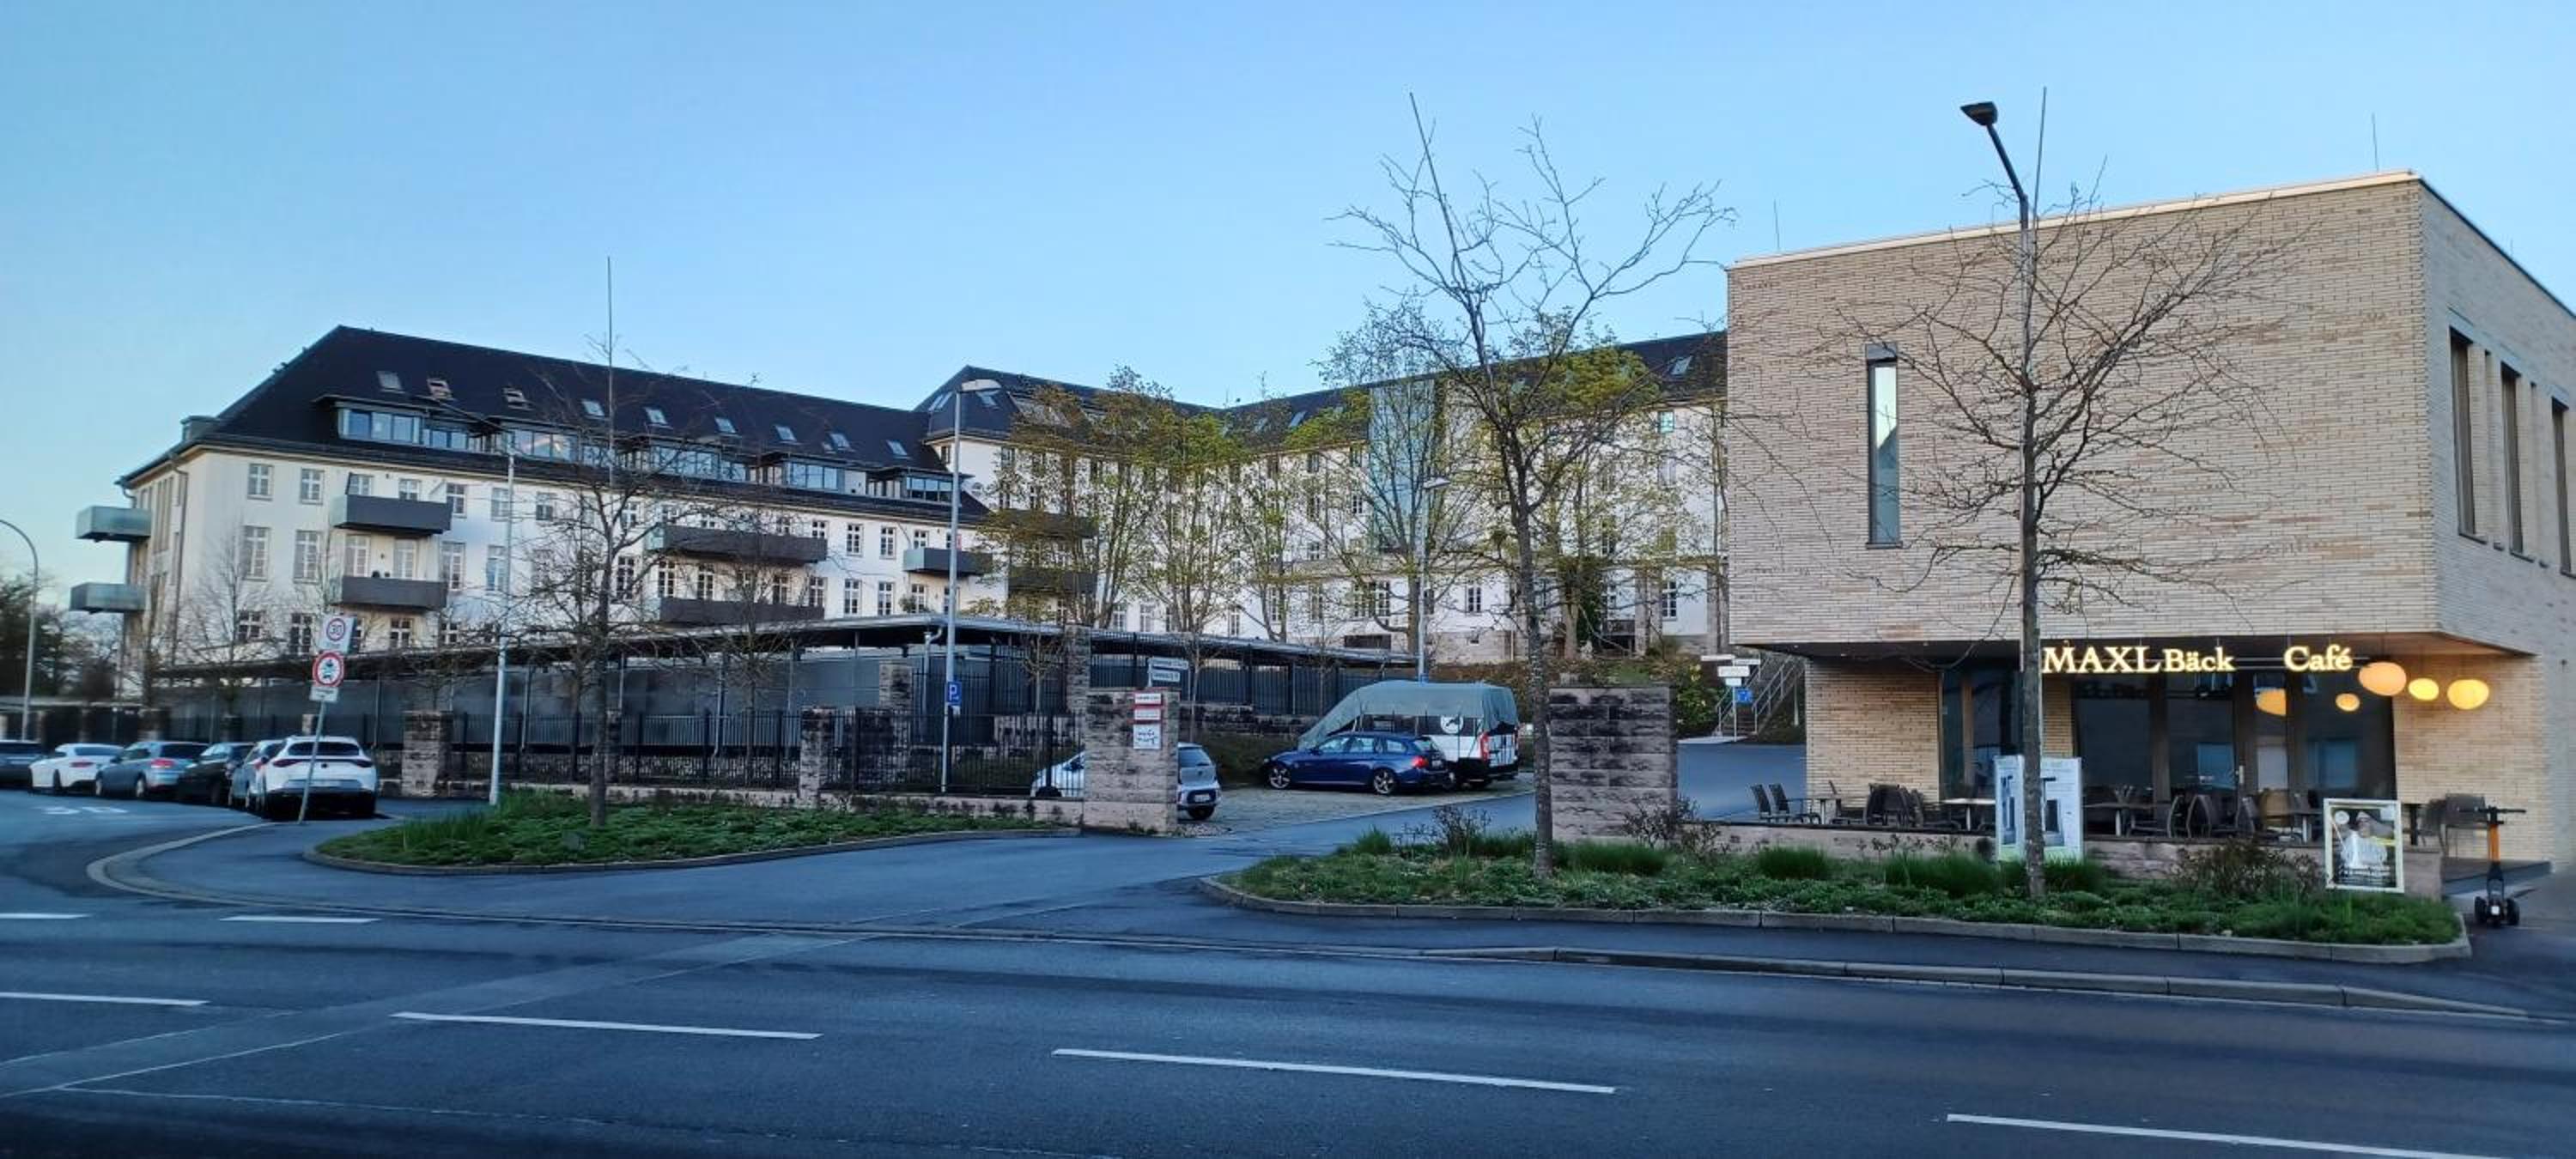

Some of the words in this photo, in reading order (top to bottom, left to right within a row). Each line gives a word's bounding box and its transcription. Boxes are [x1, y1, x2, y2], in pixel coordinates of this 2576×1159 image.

[329, 624, 343, 635] 30
[2041, 646, 2160, 674] MAXL
[2162, 647, 2235, 672] Bäck
[2283, 644, 2353, 672] Café
[949, 683, 957, 701] P
